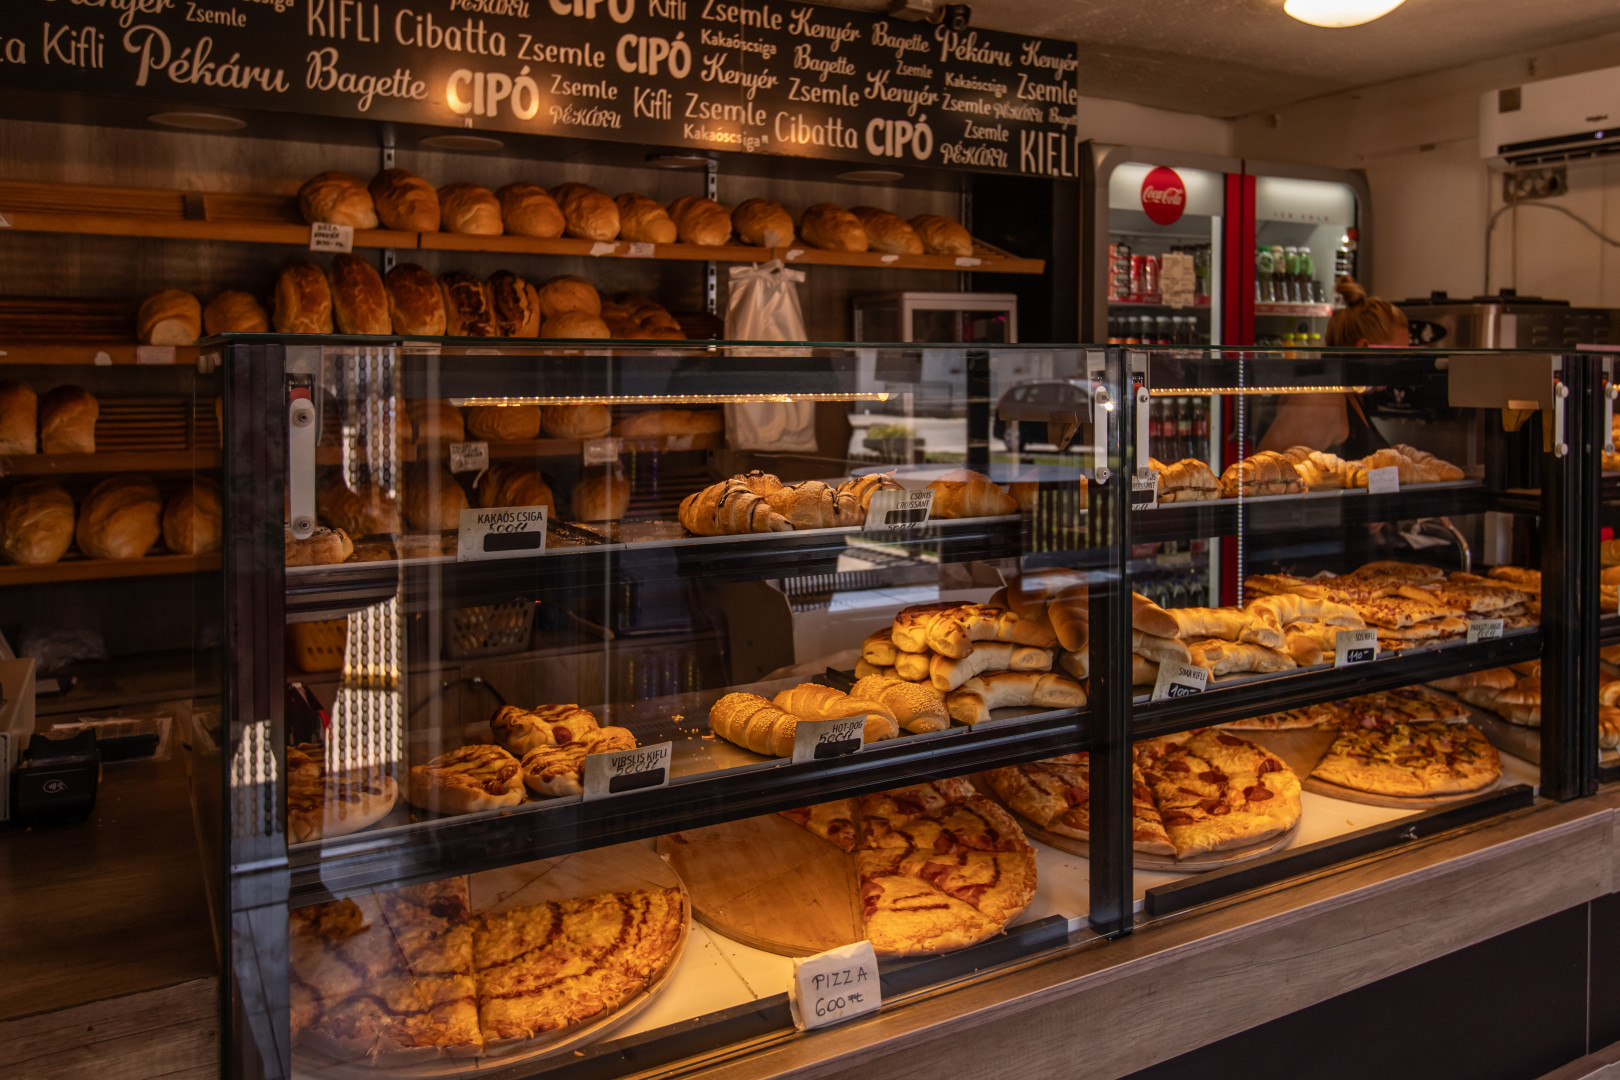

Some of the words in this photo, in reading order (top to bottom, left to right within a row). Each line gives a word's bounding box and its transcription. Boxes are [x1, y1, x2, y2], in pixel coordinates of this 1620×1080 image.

[186, 2, 246, 27] Zsemle
[307, 0, 379, 43] KIFLI
[701, 0, 782, 30] Zsemle
[788, 7, 861, 52] Kenyér
[43, 22, 105, 68] Kifli
[395, 9, 506, 57] Cibatta
[518, 33, 606, 68] Zsemle
[700, 28, 777, 60] Kakaóscsiga
[871, 21, 931, 59] Bagette
[934, 24, 1013, 67] Pékáru
[123, 24, 289, 93] Pékáru
[616, 31, 692, 79] CIPÓ
[794, 44, 856, 82] Bagette
[896, 59, 933, 79] Zsemle
[1020, 40, 1078, 80] Kenyér
[306, 47, 429, 112] Bagette
[446, 65, 540, 120] CIPÓ
[550, 74, 618, 100] Zsemle
[701, 52, 779, 100] Kenyér
[788, 78, 860, 107] Zsemle
[864, 69, 939, 117] Kenyér
[1016, 72, 1078, 106] Zsemle
[634, 86, 673, 120] Kifli
[685, 92, 767, 126] Zsemle
[941, 93, 992, 115] Zsemle
[683, 123, 761, 152] Kakaóscsiga
[775, 111, 859, 149] Cibatta
[865, 114, 933, 161] CIPÓ
[964, 119, 1009, 142] Zsemle
[517, 511, 543, 522] CSIGA
[611, 753, 645, 768] VIRSLIS
[646, 748, 667, 762] KIFLI
[812, 966, 868, 990] PIZZA
